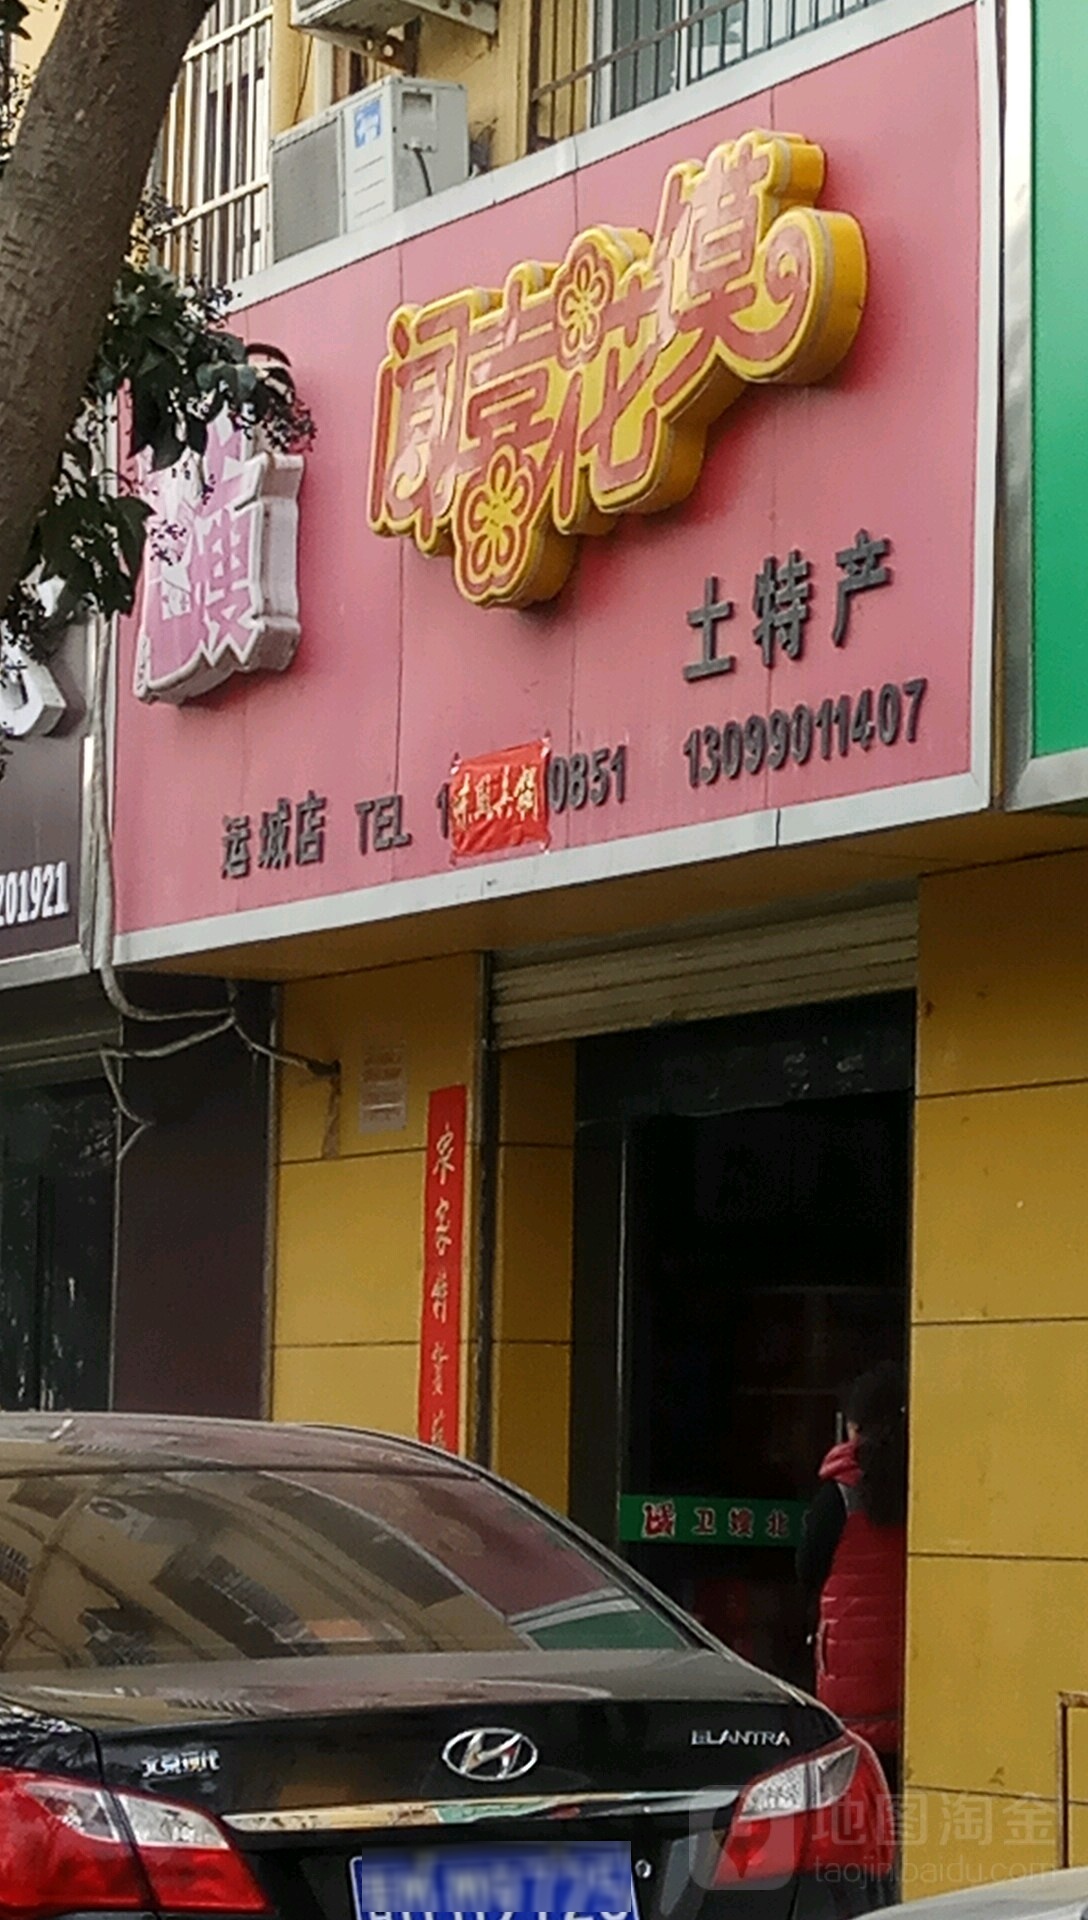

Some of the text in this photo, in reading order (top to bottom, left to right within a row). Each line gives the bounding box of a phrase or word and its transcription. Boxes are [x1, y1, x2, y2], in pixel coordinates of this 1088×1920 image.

[683, 528, 892, 684] 土特产
[222, 790, 327, 880] 运城店
[355, 794, 413, 856] TEL
[683, 678, 928, 788] 13099011407
[690, 1729, 792, 1747] ELANTRA
